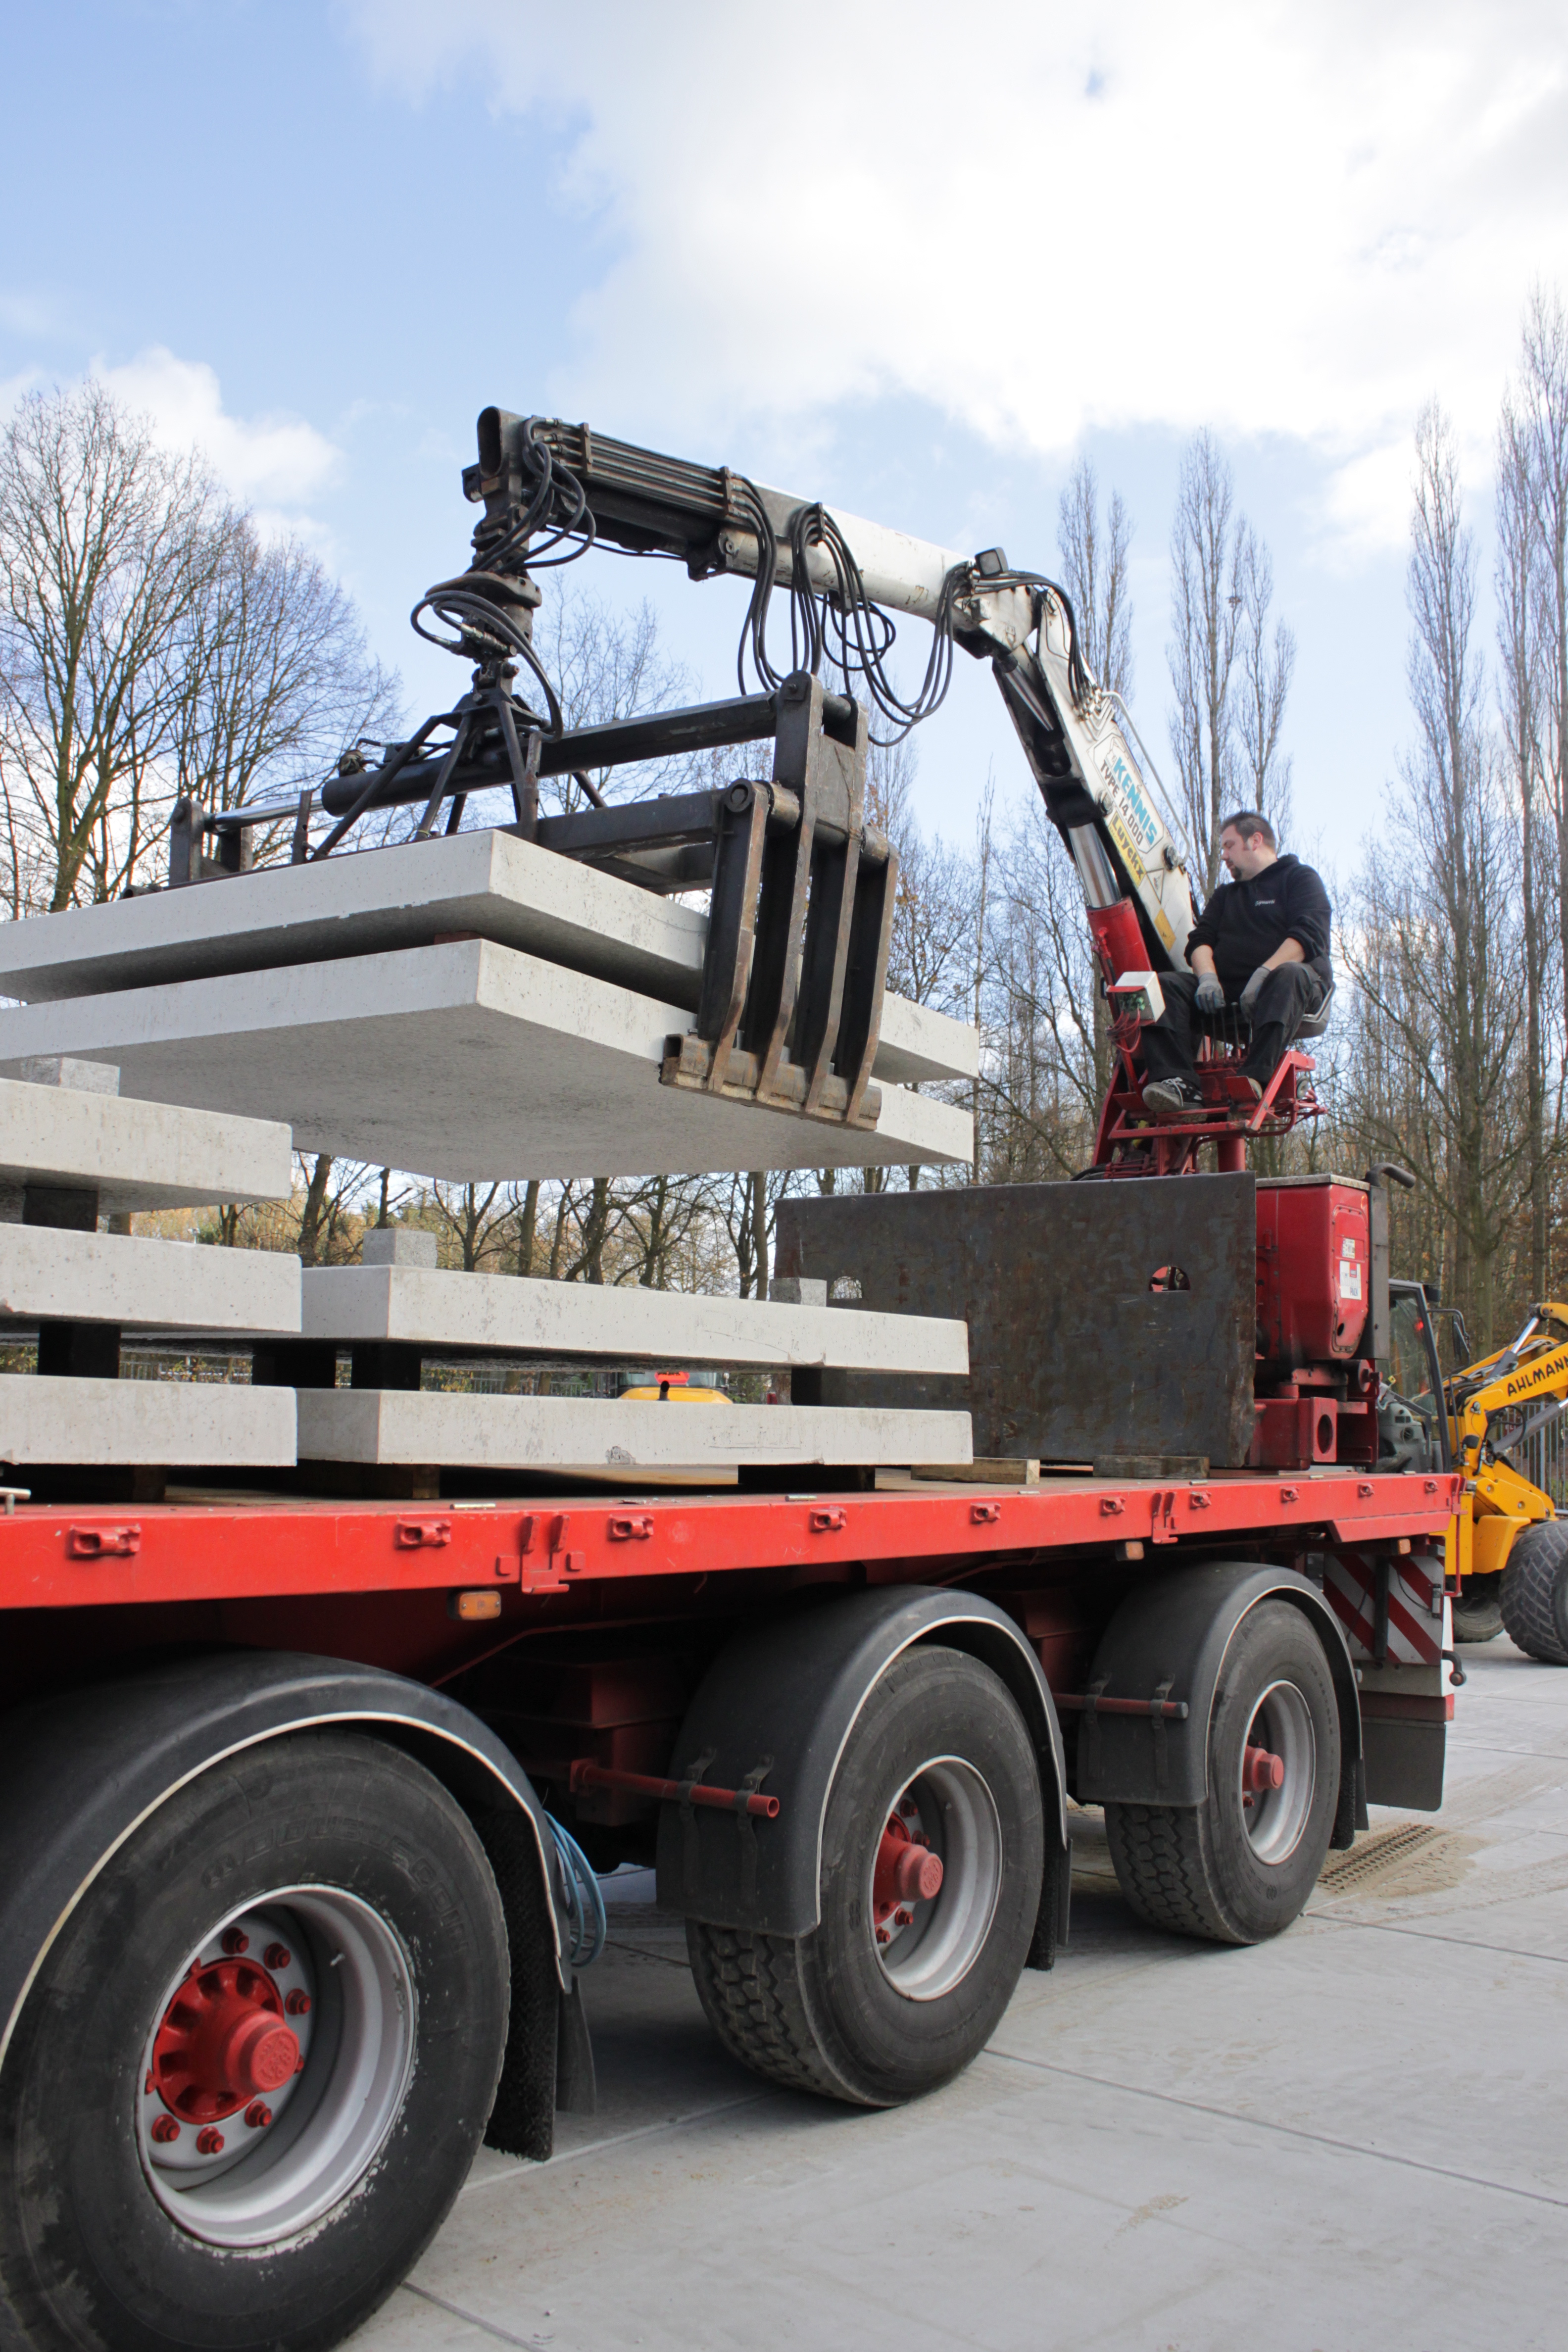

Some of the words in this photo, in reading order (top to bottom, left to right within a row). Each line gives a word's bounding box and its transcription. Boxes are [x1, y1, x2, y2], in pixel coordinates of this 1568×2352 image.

[1100, 759, 1120, 798] TYPE
[1119, 797, 1144, 846] 14.000
[1114, 756, 1158, 845] KENNIS
